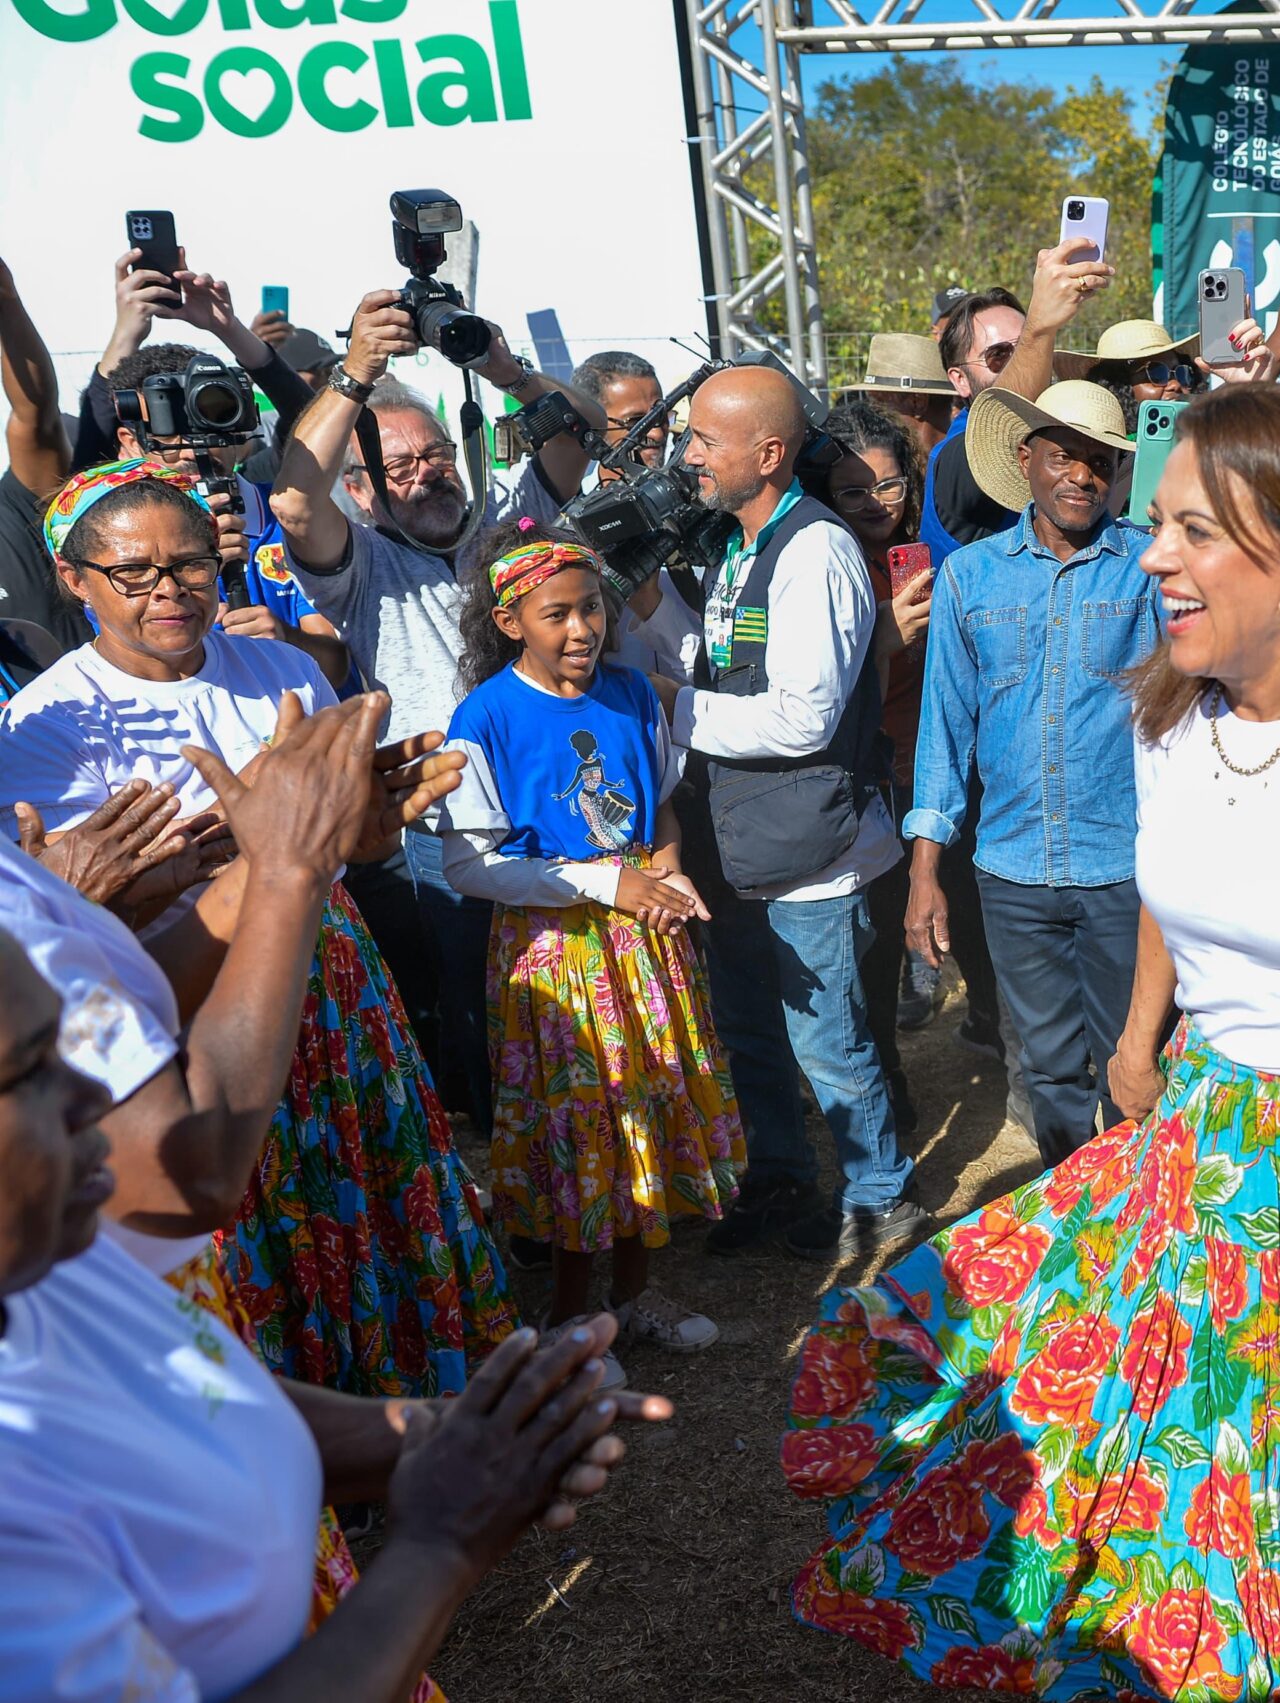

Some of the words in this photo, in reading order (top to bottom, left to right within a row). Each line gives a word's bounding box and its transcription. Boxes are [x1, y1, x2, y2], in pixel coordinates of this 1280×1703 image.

[129, 0, 533, 143] social
[1254, 58, 1270, 84] DE
[1212, 110, 1230, 192] COLÉGIO
[1231, 59, 1250, 192] TECNOLÓGICO
[1252, 88, 1269, 161] ESTADO
[1252, 164, 1267, 191] DO
[197, 364, 222, 372] Canon
